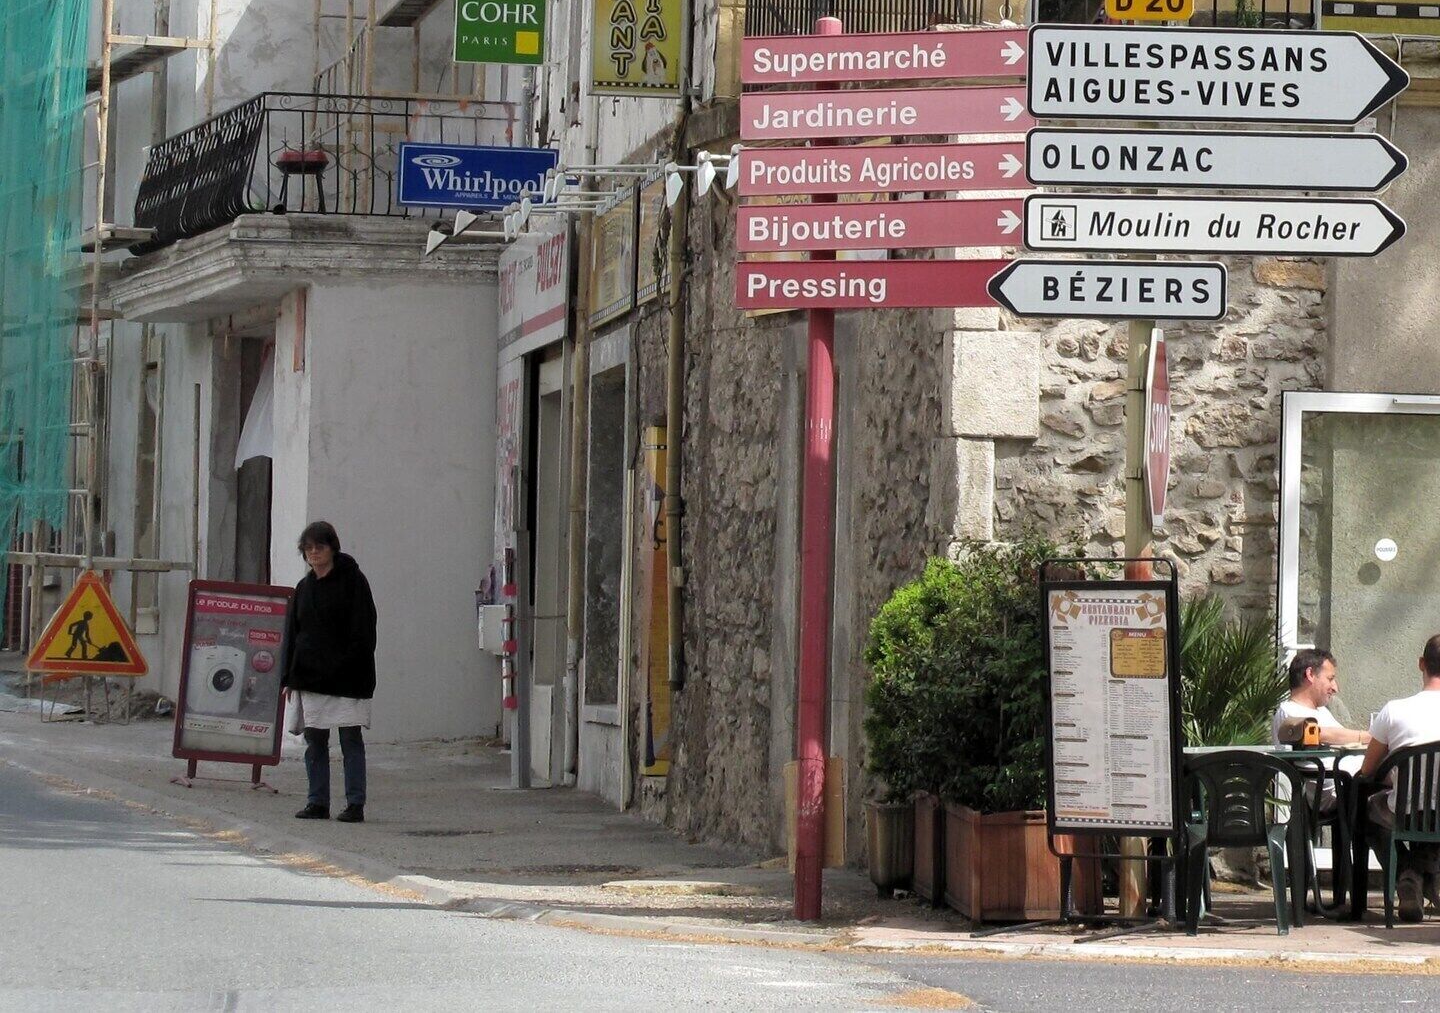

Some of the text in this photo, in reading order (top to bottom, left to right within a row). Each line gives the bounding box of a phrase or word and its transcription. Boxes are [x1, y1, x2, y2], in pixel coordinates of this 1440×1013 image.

[461, 1, 538, 25] COHR
[462, 35, 508, 46] PARIS
[753, 42, 947, 78] Supermarché
[1046, 41, 1328, 73] VILLESPASSANS
[1043, 78, 1301, 108] AIGUES-VIVES
[753, 100, 918, 132] Jardinerie
[750, 155, 975, 187] Produits Agricoles
[1042, 143, 1213, 173] OLONZAC
[421, 168, 544, 200] Whirlpool
[749, 213, 906, 247] Bijouterie
[1088, 211, 1361, 241] Moulin du Rocher
[747, 272, 887, 303] Pressing
[1042, 270, 1210, 304] BÉZIERS
[1151, 403, 1168, 453] STOP
